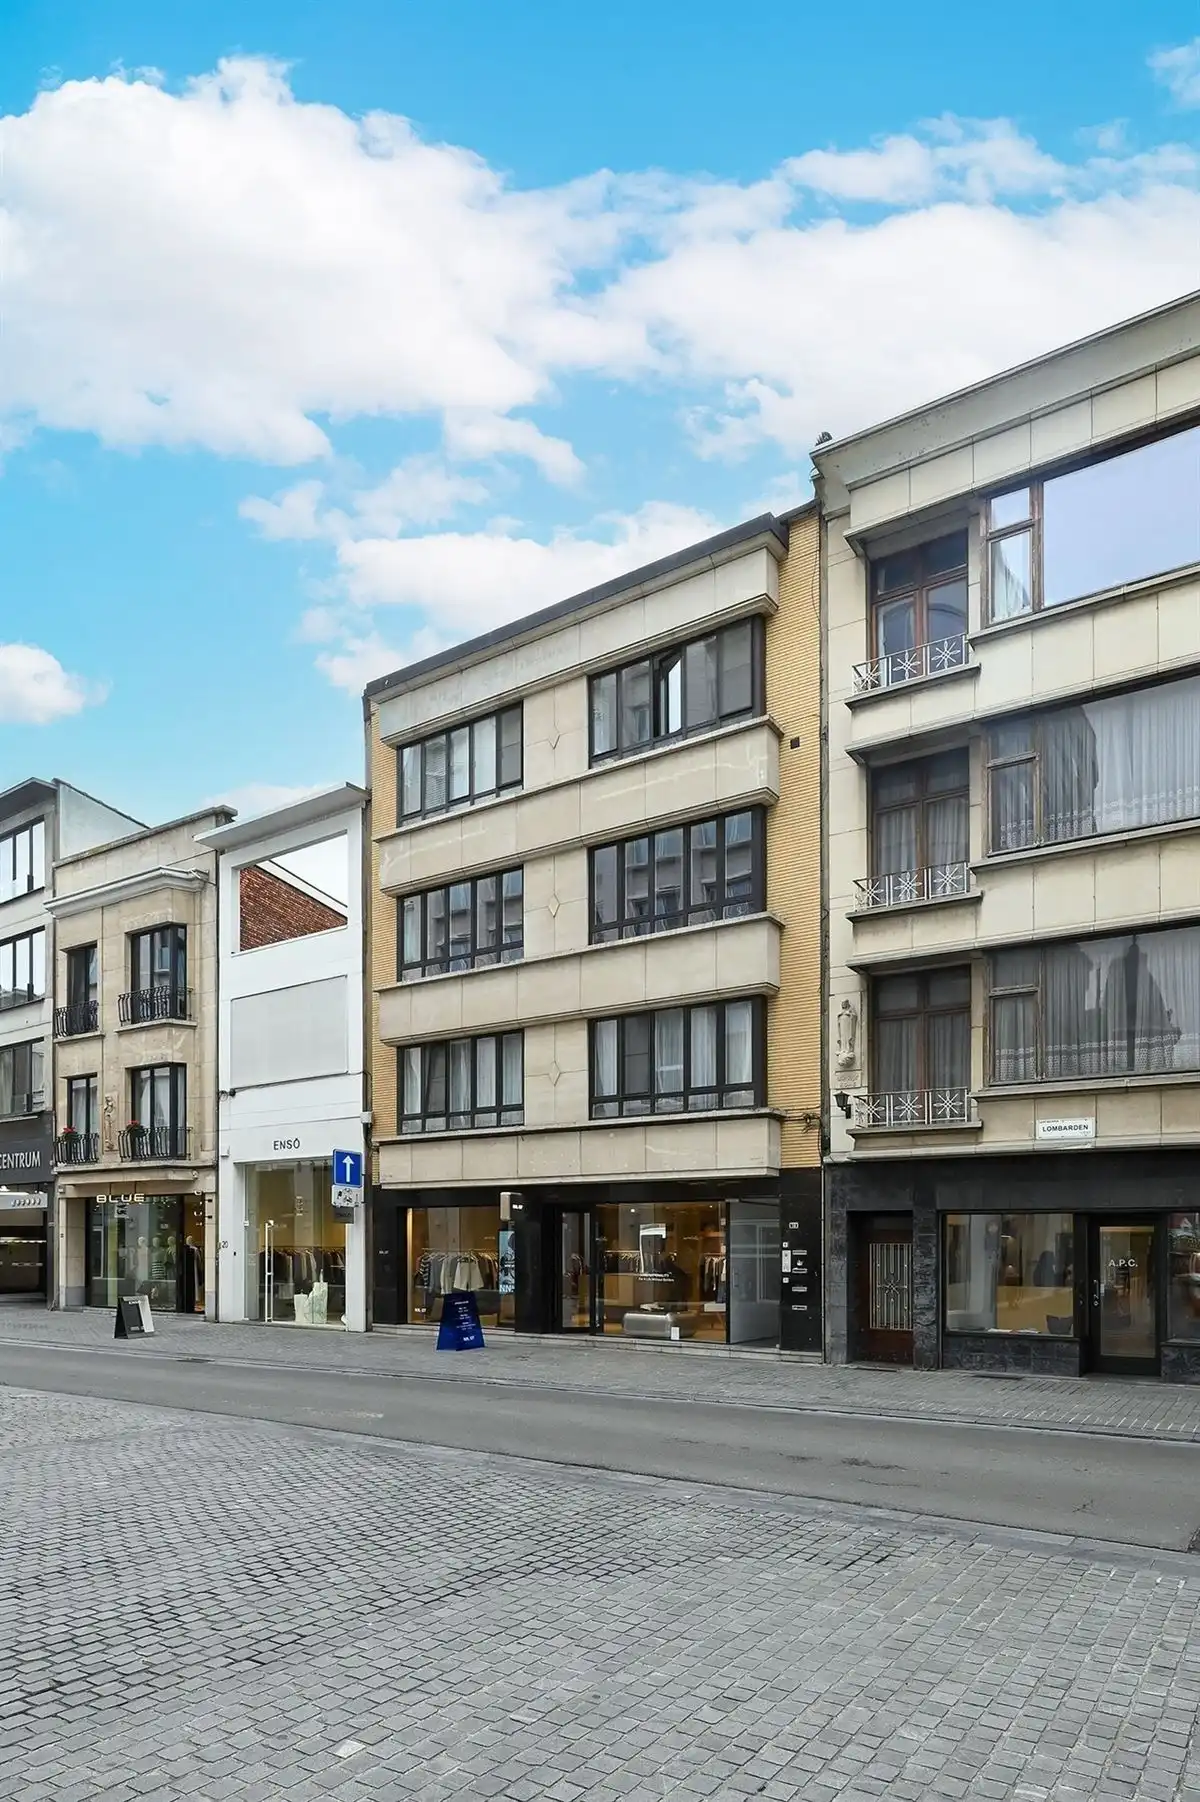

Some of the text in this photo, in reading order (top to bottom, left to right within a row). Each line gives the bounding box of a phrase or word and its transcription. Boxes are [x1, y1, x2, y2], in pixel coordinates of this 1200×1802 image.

[1042, 1124, 1089, 1132] LOMBARDEN
[96, 1193, 145, 1203] BLUE
[1109, 1259, 1139, 1267] A.P.C.
